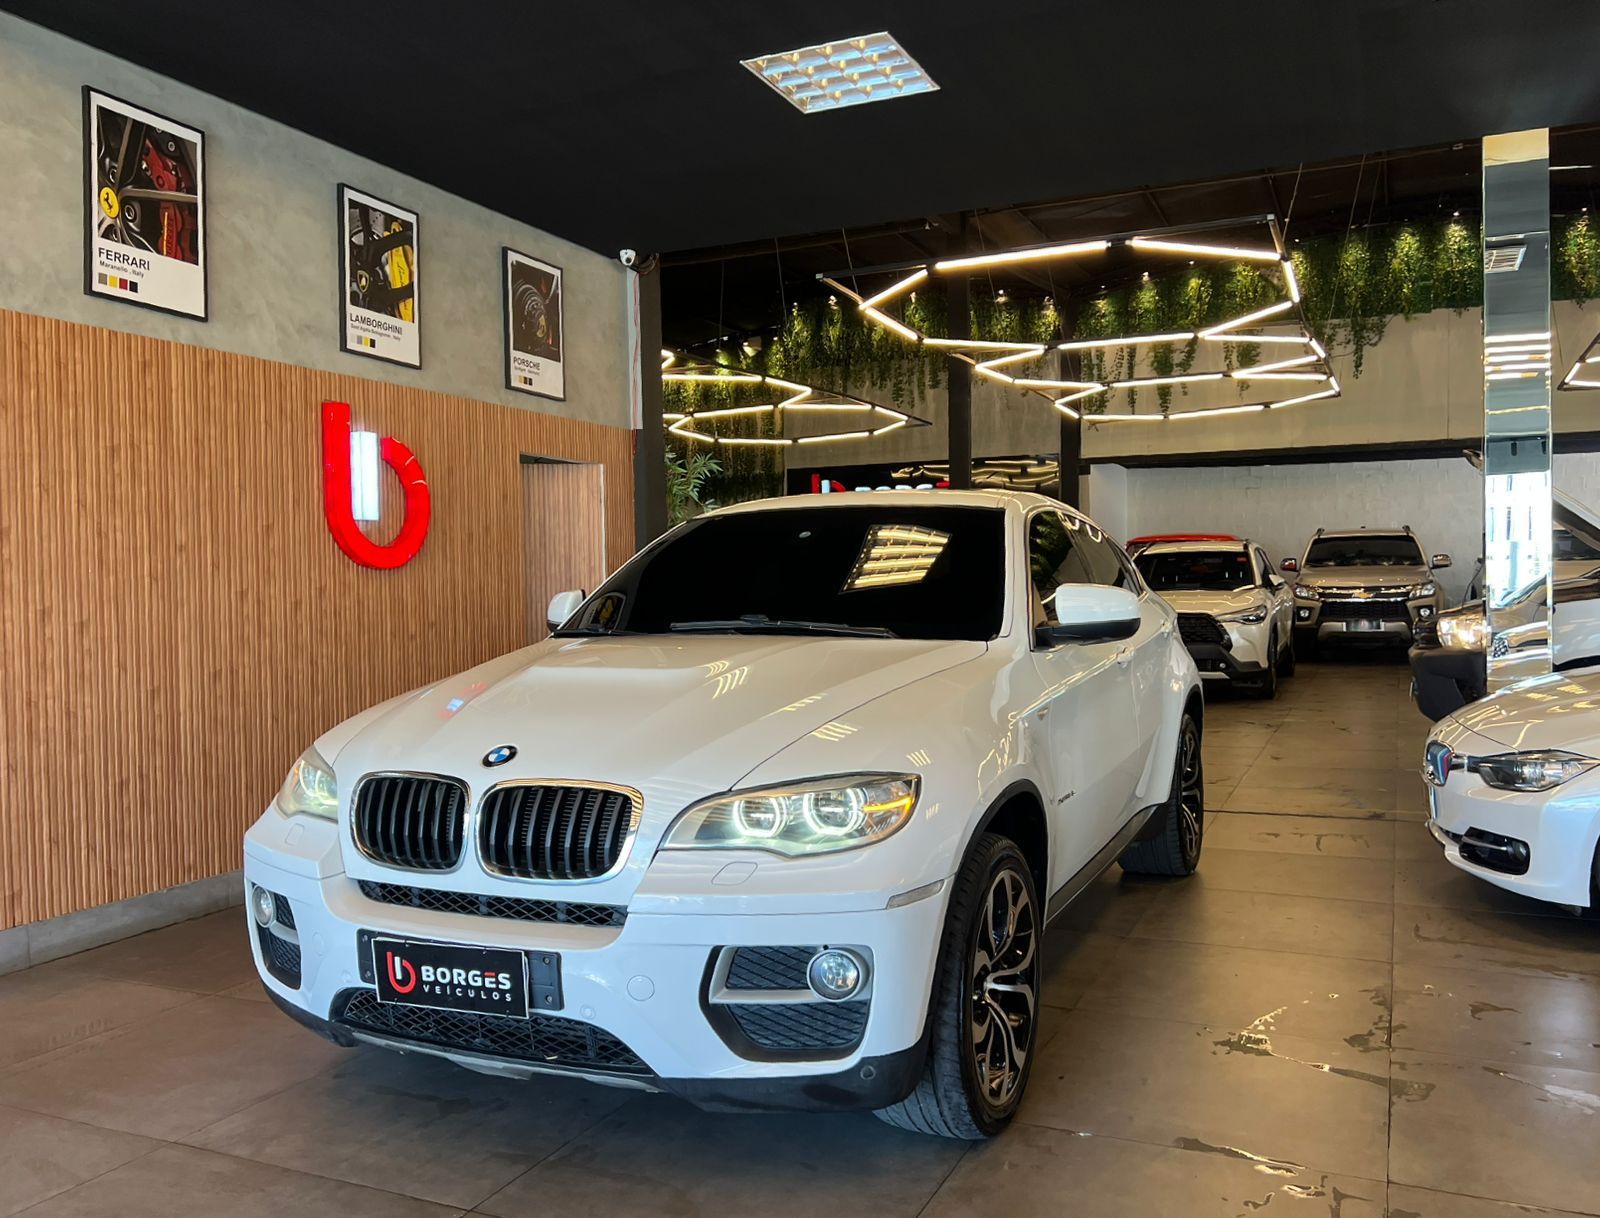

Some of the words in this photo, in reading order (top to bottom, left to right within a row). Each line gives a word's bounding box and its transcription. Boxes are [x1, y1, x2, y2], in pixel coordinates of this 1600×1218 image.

[98, 247, 150, 271] FERRARI
[350, 312, 403, 335] LAMBORGHINI
[513, 356, 541, 371] PORSCHE
[420, 964, 512, 990] BORGES
